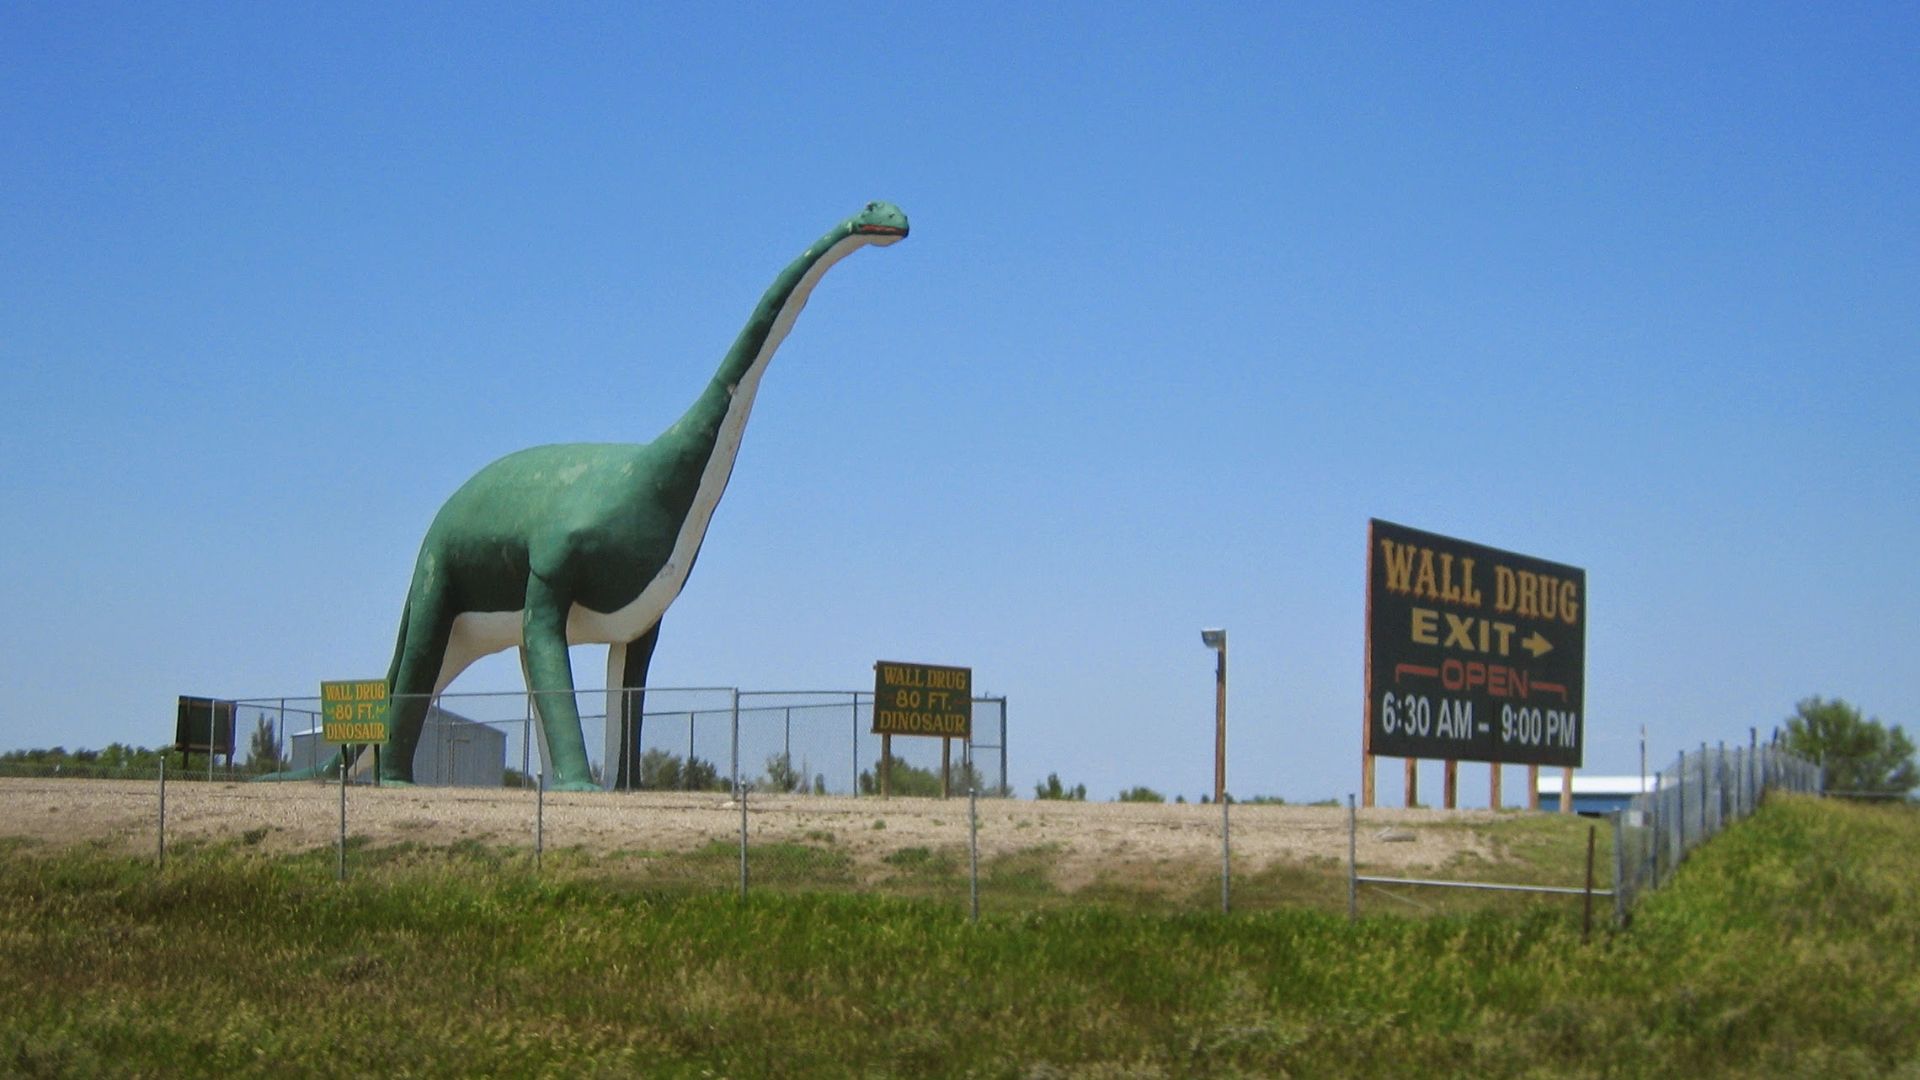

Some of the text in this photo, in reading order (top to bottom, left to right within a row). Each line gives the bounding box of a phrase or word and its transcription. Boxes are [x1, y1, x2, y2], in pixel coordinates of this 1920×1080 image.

[1381, 539, 1578, 624] WALL DRUG
[1411, 607, 1516, 656] EXIT
[884, 665, 966, 690] WALL DRUG
[1442, 659, 1528, 698] OPEN
[325, 682, 384, 700] WALL DRUG
[896, 689, 952, 711] 80 FT.
[335, 704, 352, 720] 80
[880, 711, 965, 733] DINOSAUR
[1382, 692, 1430, 736] 6:30
[1436, 699, 1472, 740] AM
[1502, 704, 1542, 745] 9:00
[1547, 711, 1576, 748] PM
[326, 723, 385, 740] DINOSAUR
